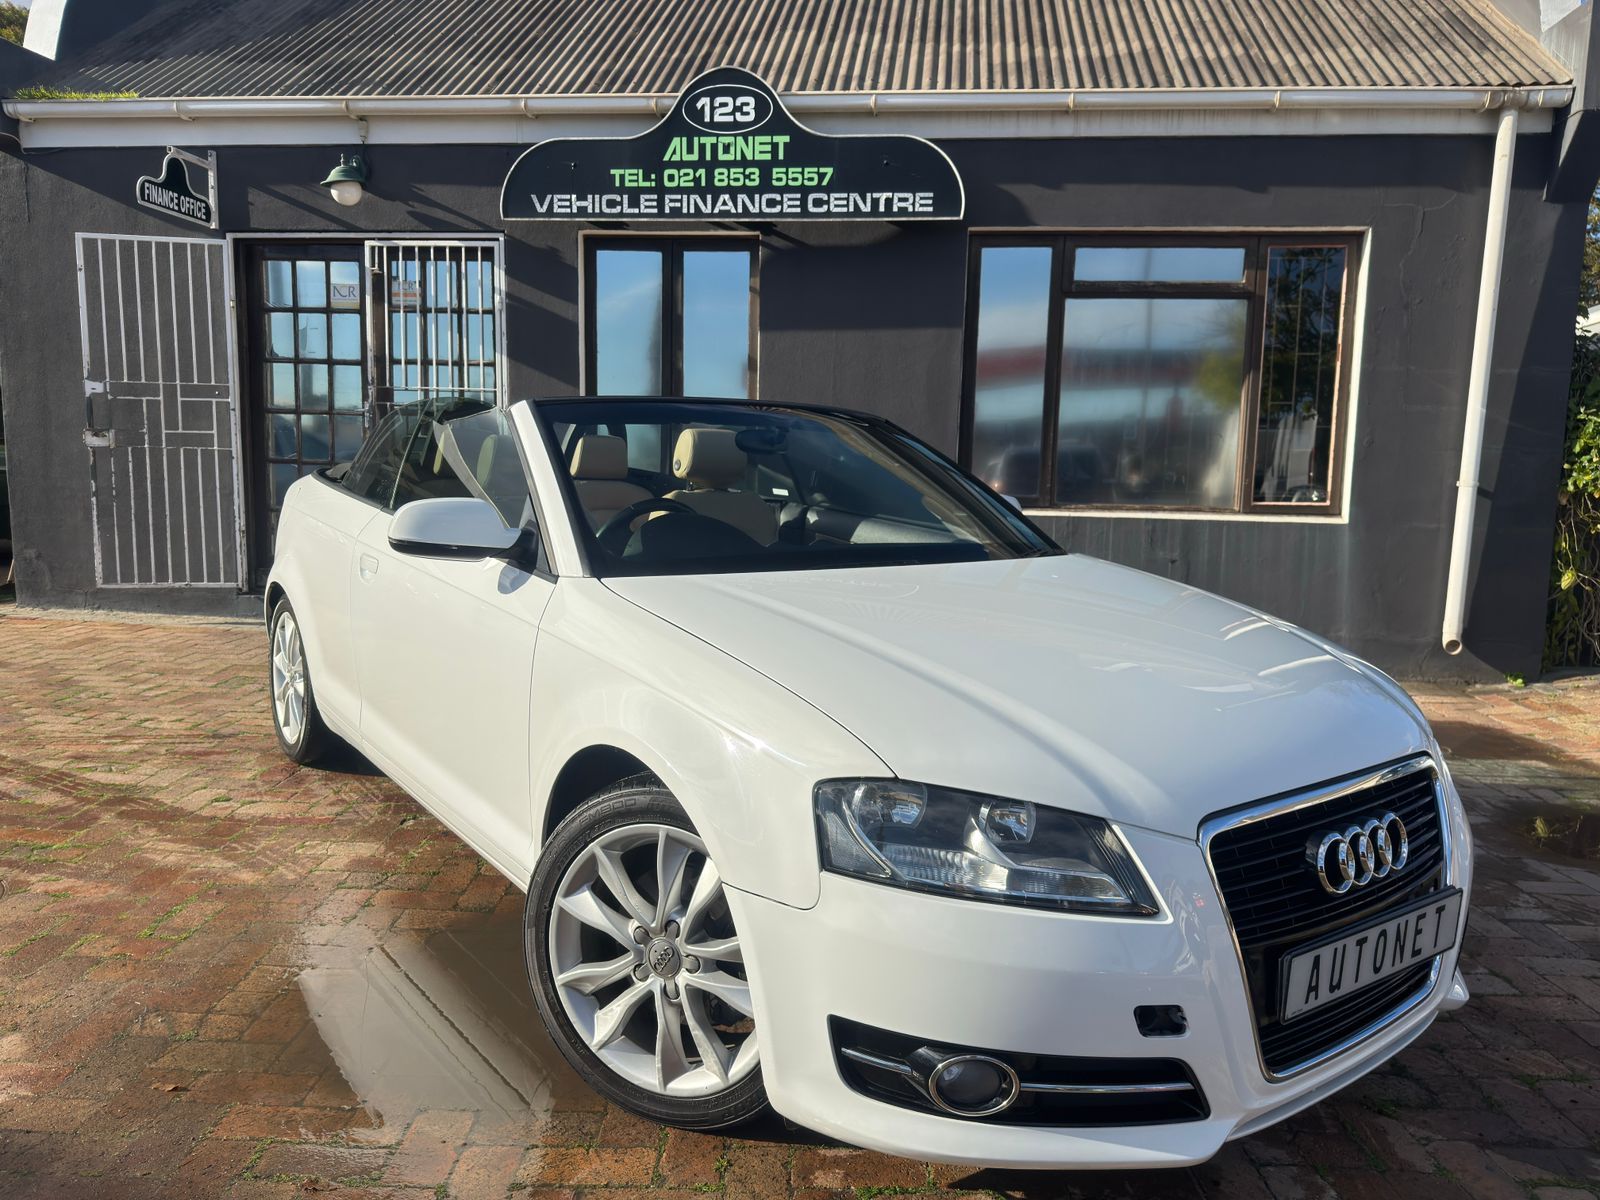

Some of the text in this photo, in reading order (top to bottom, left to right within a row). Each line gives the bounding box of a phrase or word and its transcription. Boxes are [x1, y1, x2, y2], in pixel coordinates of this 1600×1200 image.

[696, 96, 756, 123] 123
[662, 135, 790, 161] AUTONET
[610, 167, 834, 187] TEL: 021 853 5557
[144, 182, 206, 220] FINANCE OFFICE
[530, 192, 934, 214] VEHICLE FINANCE CENTRE
[1304, 904, 1446, 1005] AUTONET
